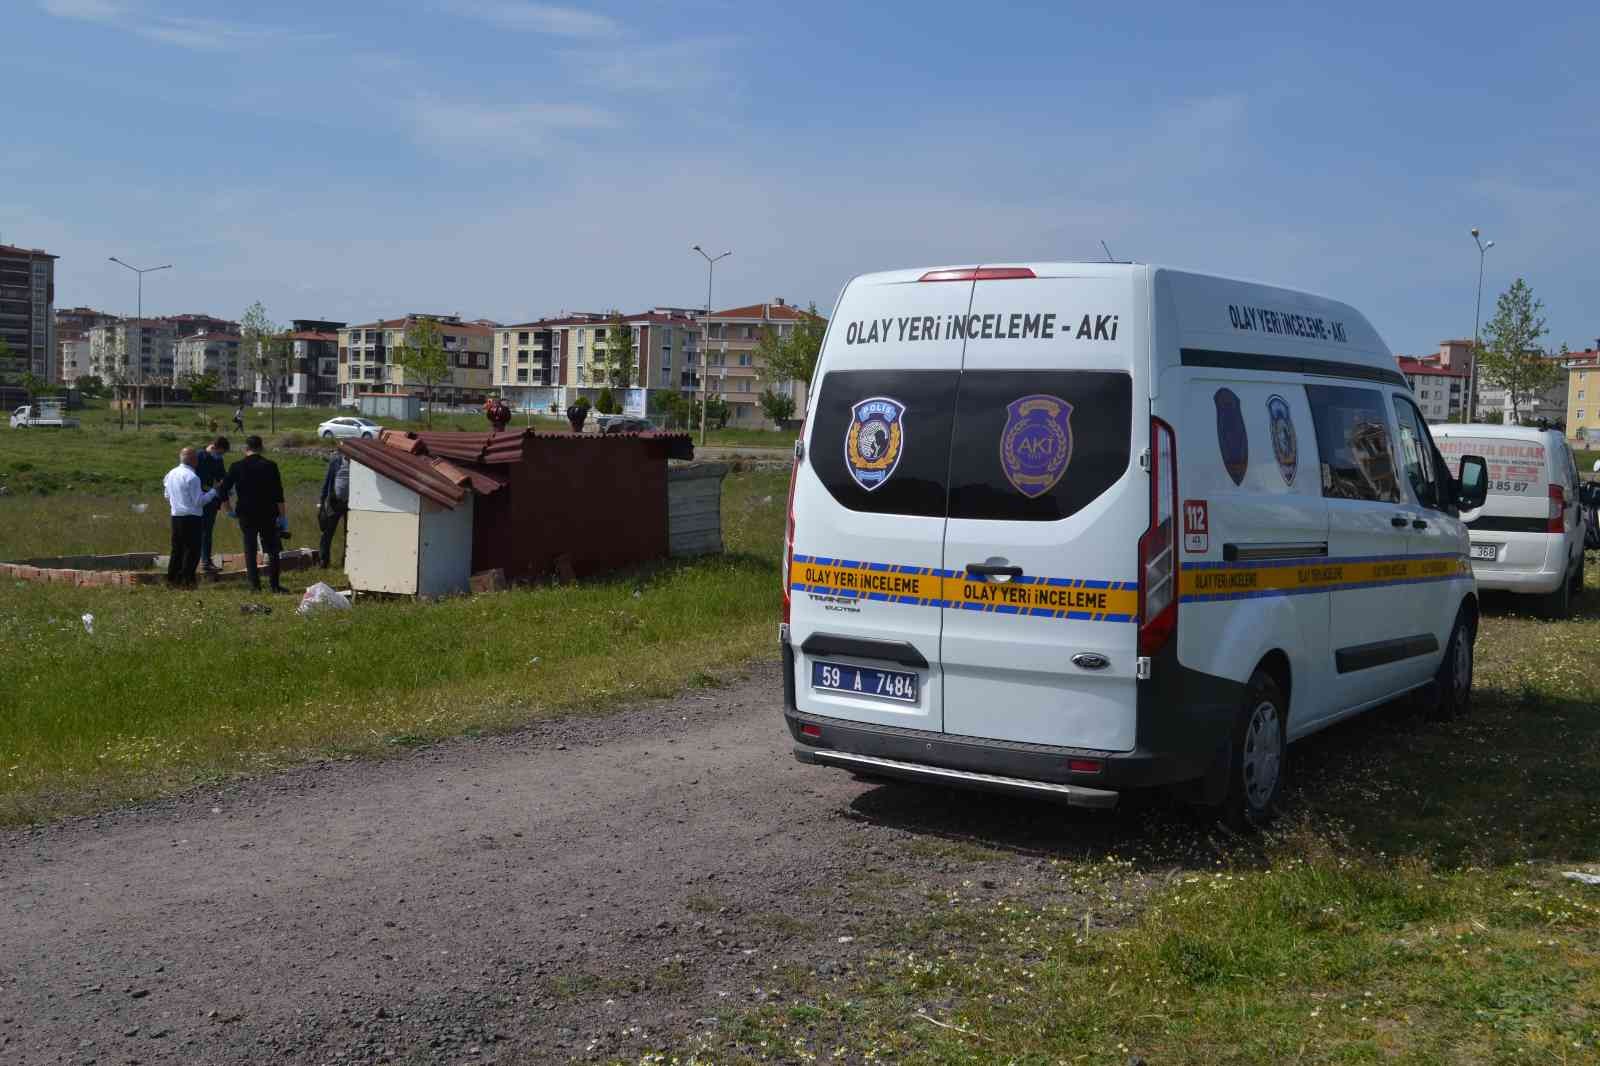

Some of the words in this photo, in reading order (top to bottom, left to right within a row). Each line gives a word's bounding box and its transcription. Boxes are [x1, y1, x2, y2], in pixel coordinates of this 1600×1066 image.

[1228, 304, 1257, 331] OLAY
[846, 317, 892, 345] OLAY
[1496, 481, 1510, 491] 85
[1513, 482, 1529, 492] 87
[1187, 505, 1205, 530] 112
[1478, 546, 1495, 557] 368
[805, 568, 831, 585] OLAY
[963, 584, 997, 601] OLAY
[822, 666, 841, 687] 59
[853, 671, 862, 691] A
[876, 673, 913, 698] 7484
